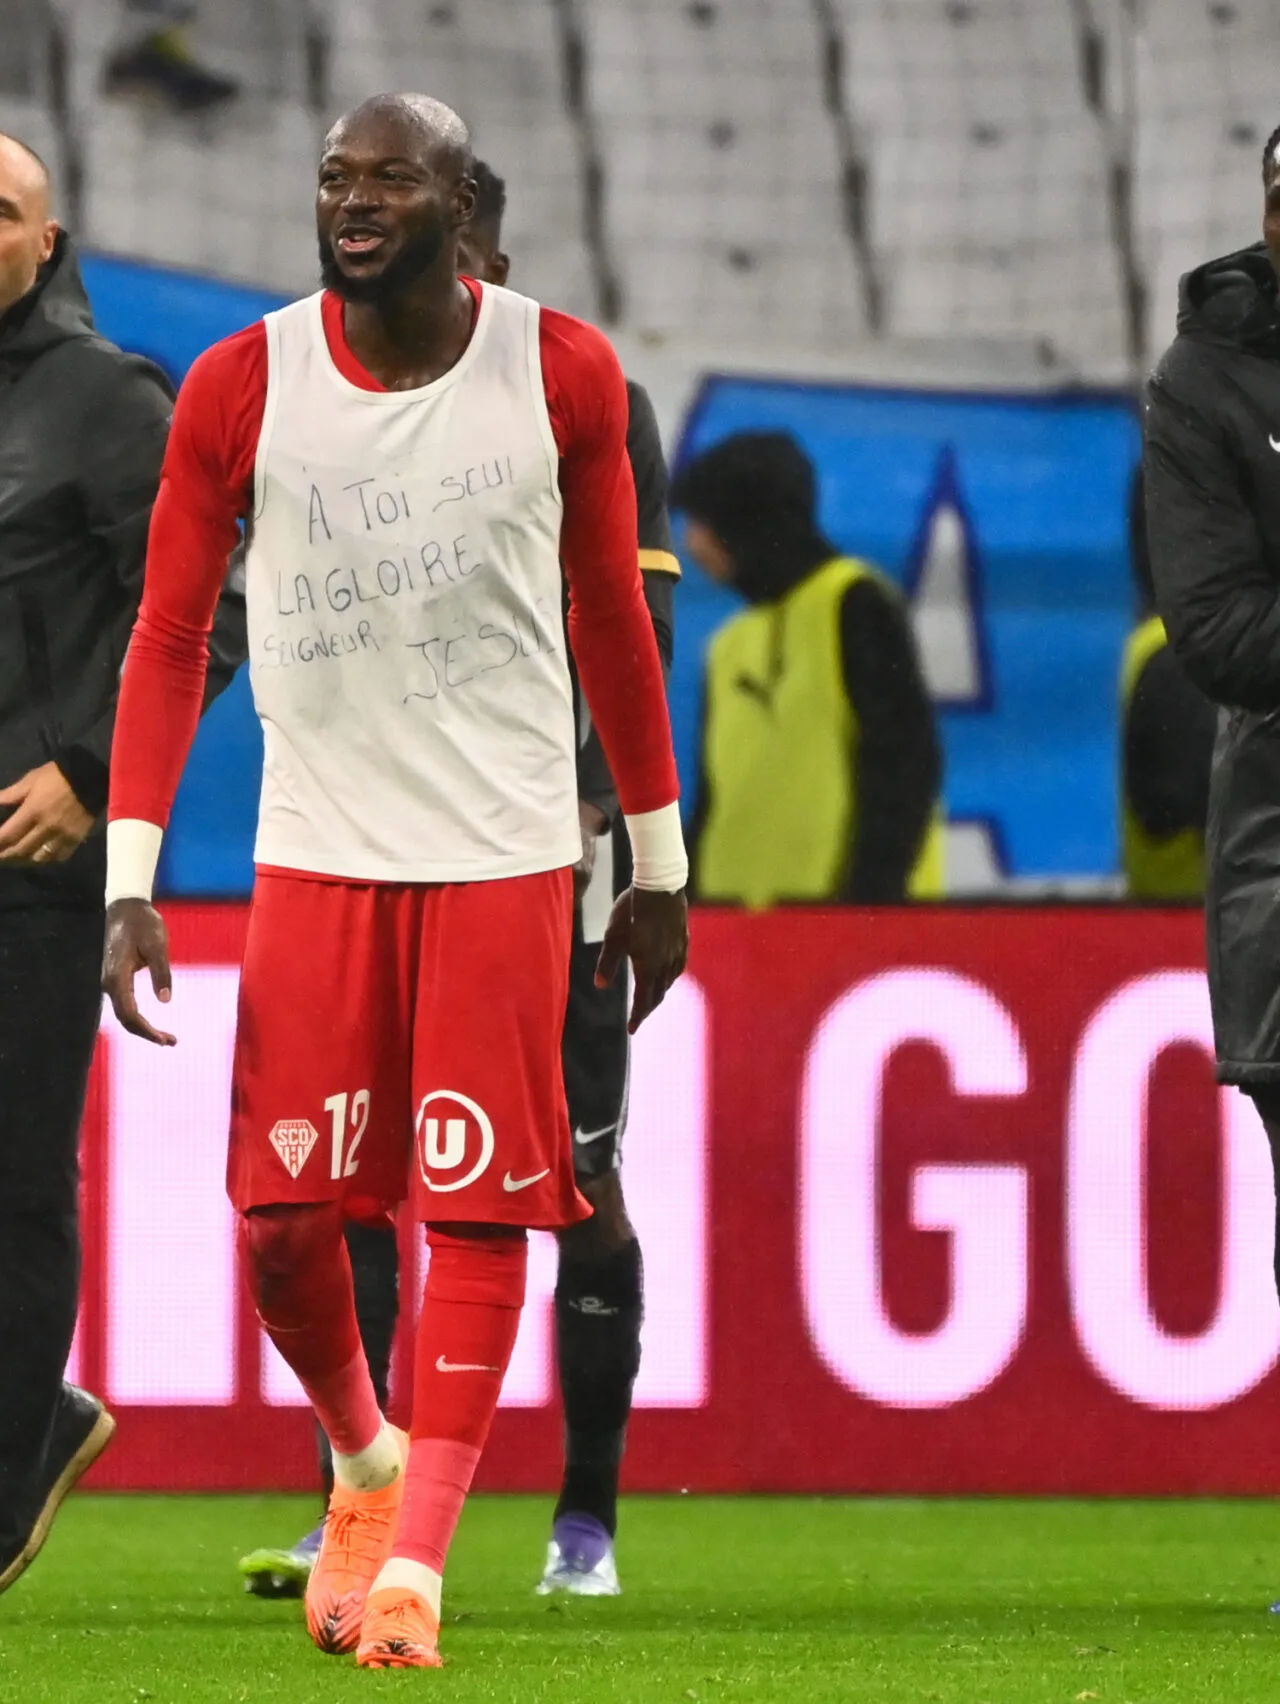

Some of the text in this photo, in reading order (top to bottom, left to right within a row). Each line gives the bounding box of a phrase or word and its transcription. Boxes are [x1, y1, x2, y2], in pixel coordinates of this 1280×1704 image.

[342, 477, 410, 531] TOI
[277, 1128, 310, 1146] SCO
[323, 1088, 371, 1181] 12
[424, 1118, 466, 1169] U
